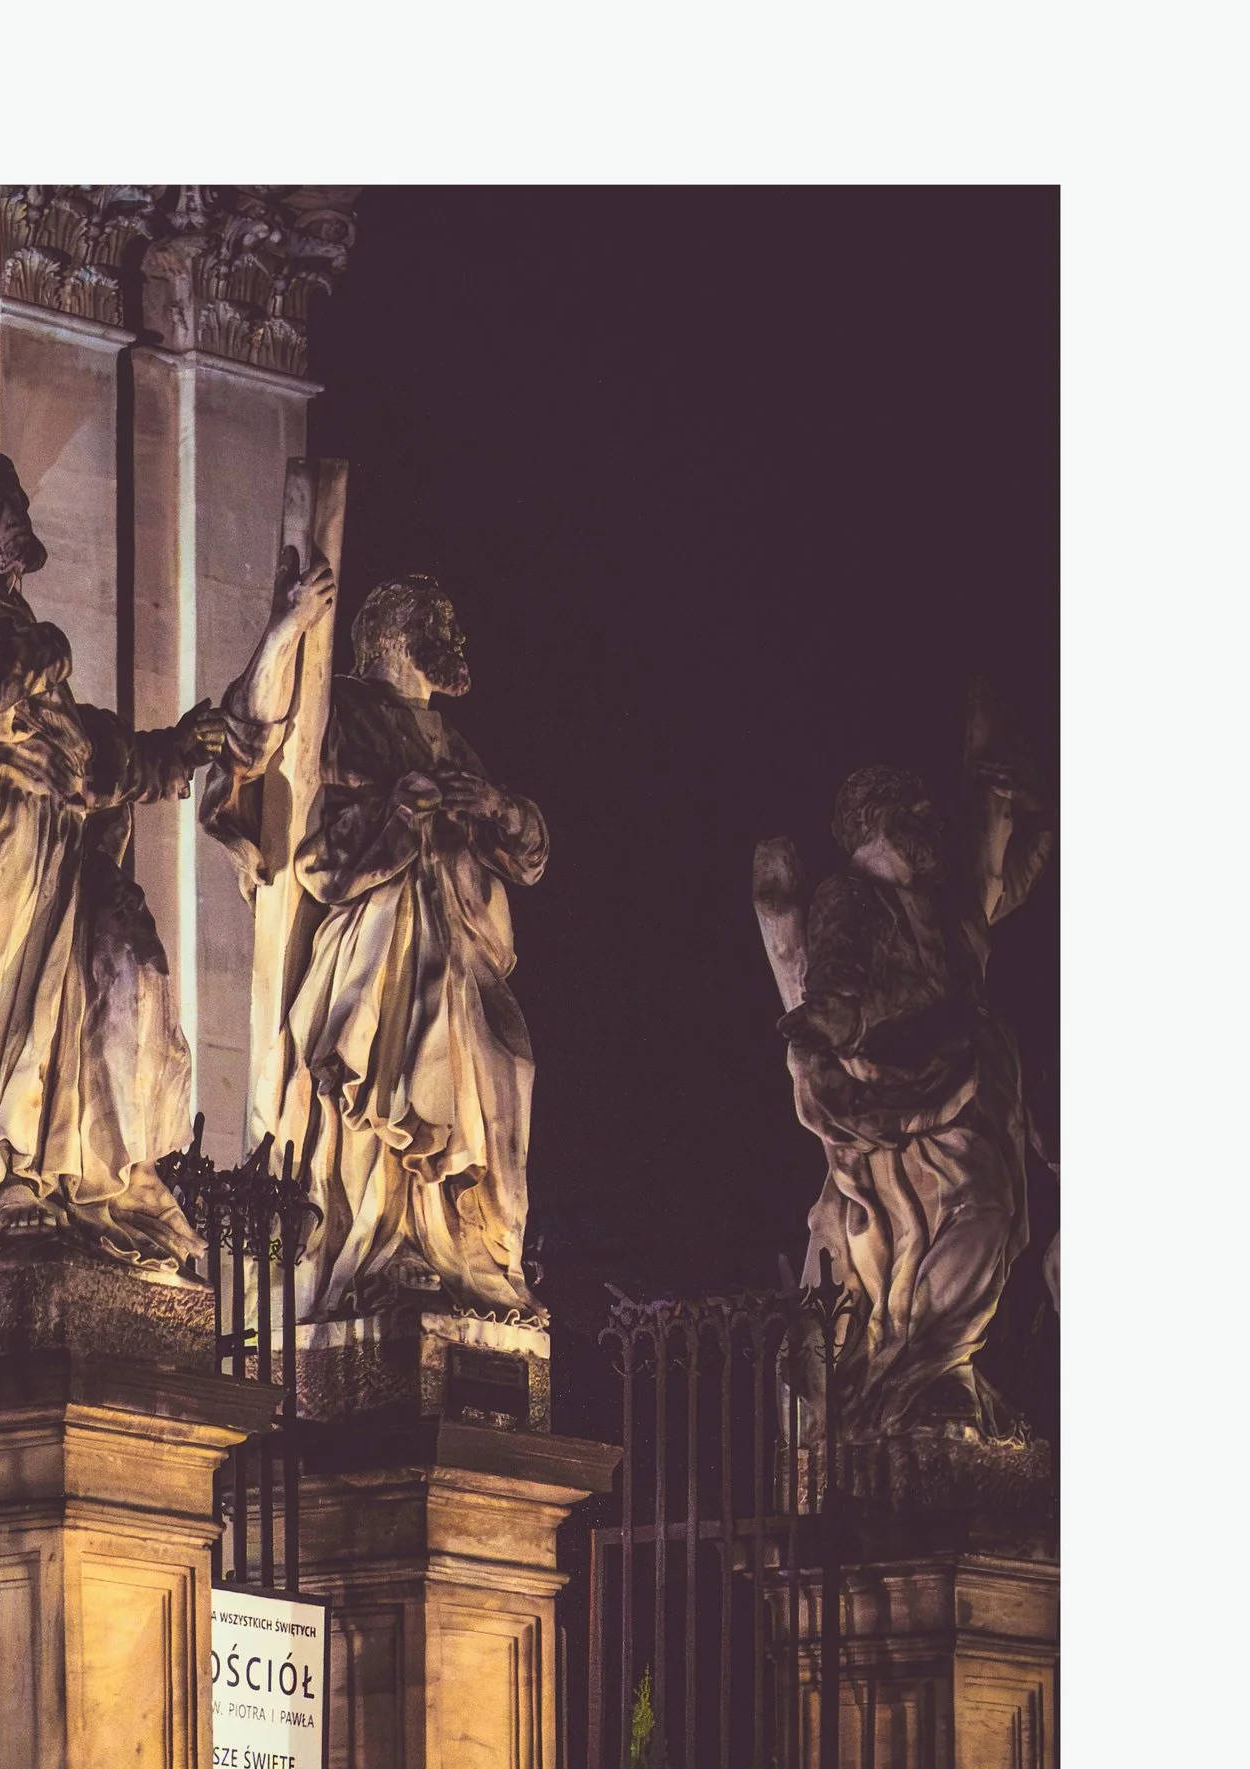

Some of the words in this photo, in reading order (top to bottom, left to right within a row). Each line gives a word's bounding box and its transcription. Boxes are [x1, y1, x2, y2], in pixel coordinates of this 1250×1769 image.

[220, 1612, 272, 1630] WSZYSTKICH
[275, 1618, 316, 1638] ŚWIĘTYCH
[229, 1703, 266, 1721] PIOTRA
[271, 1709, 275, 1723] I
[280, 1710, 314, 1728] PAWŁA
[213, 1746, 238, 1768] SZE
